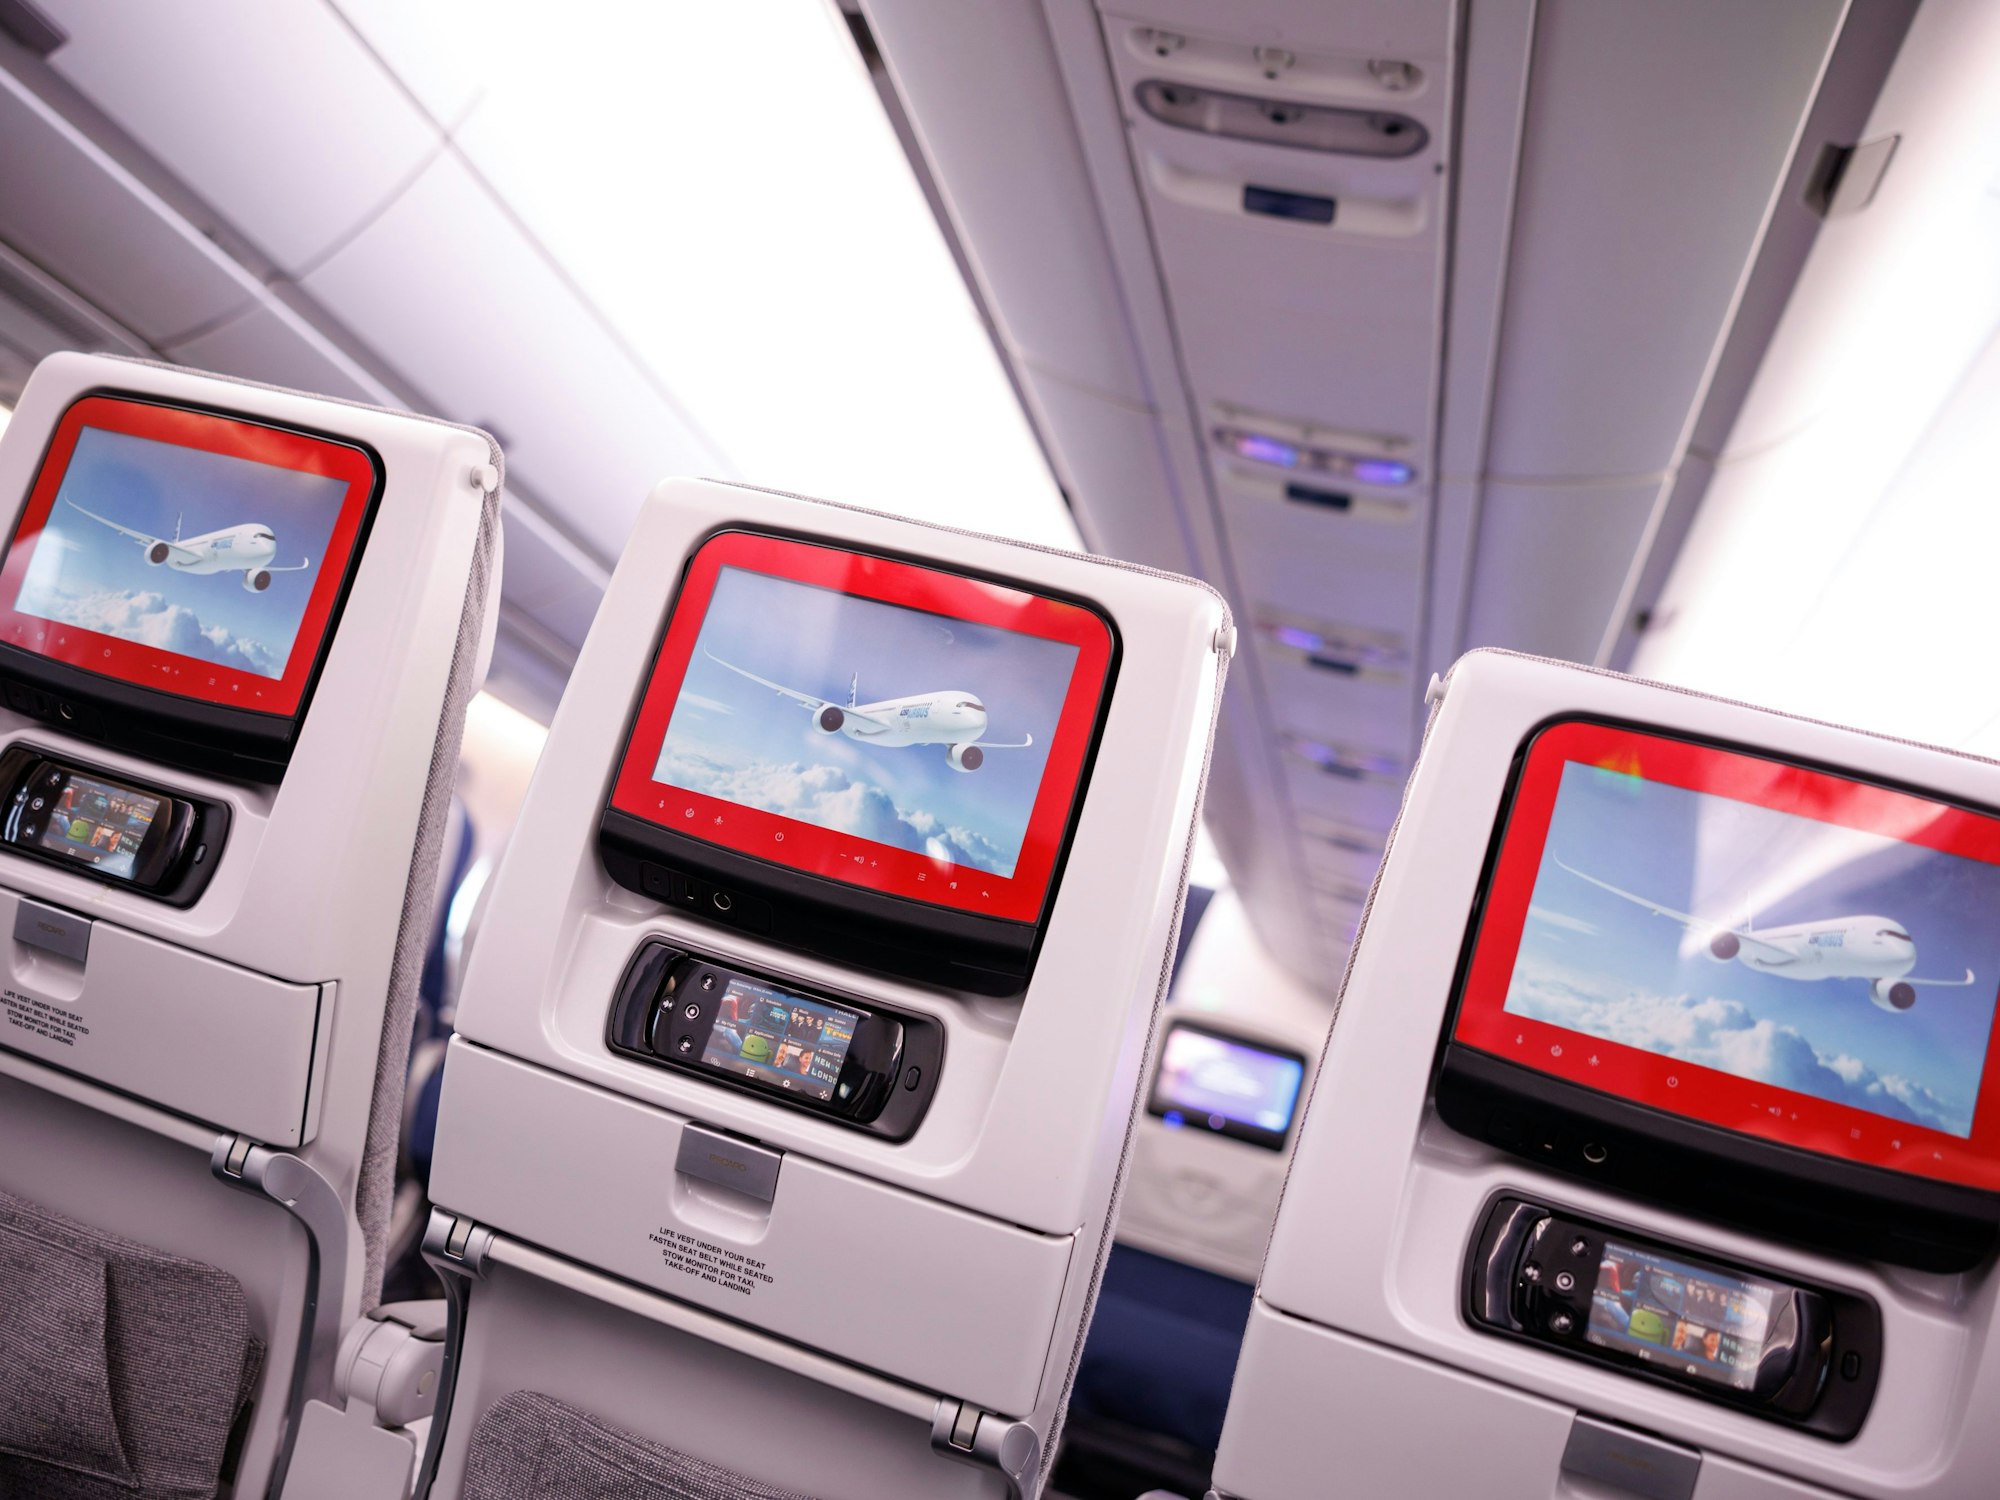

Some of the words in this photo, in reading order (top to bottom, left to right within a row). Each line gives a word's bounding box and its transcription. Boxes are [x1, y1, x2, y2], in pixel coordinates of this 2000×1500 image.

[0, 997, 18, 1008] ASTEN
[18, 1004, 33, 1014] SEAT
[33, 1010, 48, 1019] BELT
[48, 1015, 66, 1026] WHILE
[67, 1022, 90, 1035] SEATED
[4, 989, 16, 999] LIFE
[17, 994, 31, 1004] VEST
[31, 1000, 51, 1011] UNDER
[52, 1007, 67, 1017] YOUR
[68, 1013, 83, 1023] SEAT
[7, 1008, 23, 1019] STOW
[24, 1015, 49, 1029] MONITOR
[50, 1024, 62, 1033] FOR
[9, 1017, 35, 1031] TAKE-OFF
[36, 1028, 49, 1037] AND
[48, 1032, 74, 1046] LANDING
[649, 1233, 677, 1249] FASTEN
[678, 1244, 698, 1256] SEAT
[698, 1251, 718, 1263] BELT
[719, 1259, 742, 1273] WHILE
[743, 1268, 774, 1283] SEATED
[659, 1226, 675, 1238] LIFE
[677, 1233, 695, 1245] VEST
[696, 1240, 722, 1254] UNDER
[724, 1249, 745, 1262] YOUR
[745, 1258, 766, 1270] SEAT
[662, 1249, 684, 1261] STOW
[685, 1257, 719, 1274] MONITOR
[720, 1270, 736, 1281] FOR
[737, 1275, 755, 1289] TAXI,
[664, 1258, 700, 1276] TAKE-OFF
[701, 1272, 717, 1283] AND
[718, 1278, 751, 1295] LANDING
